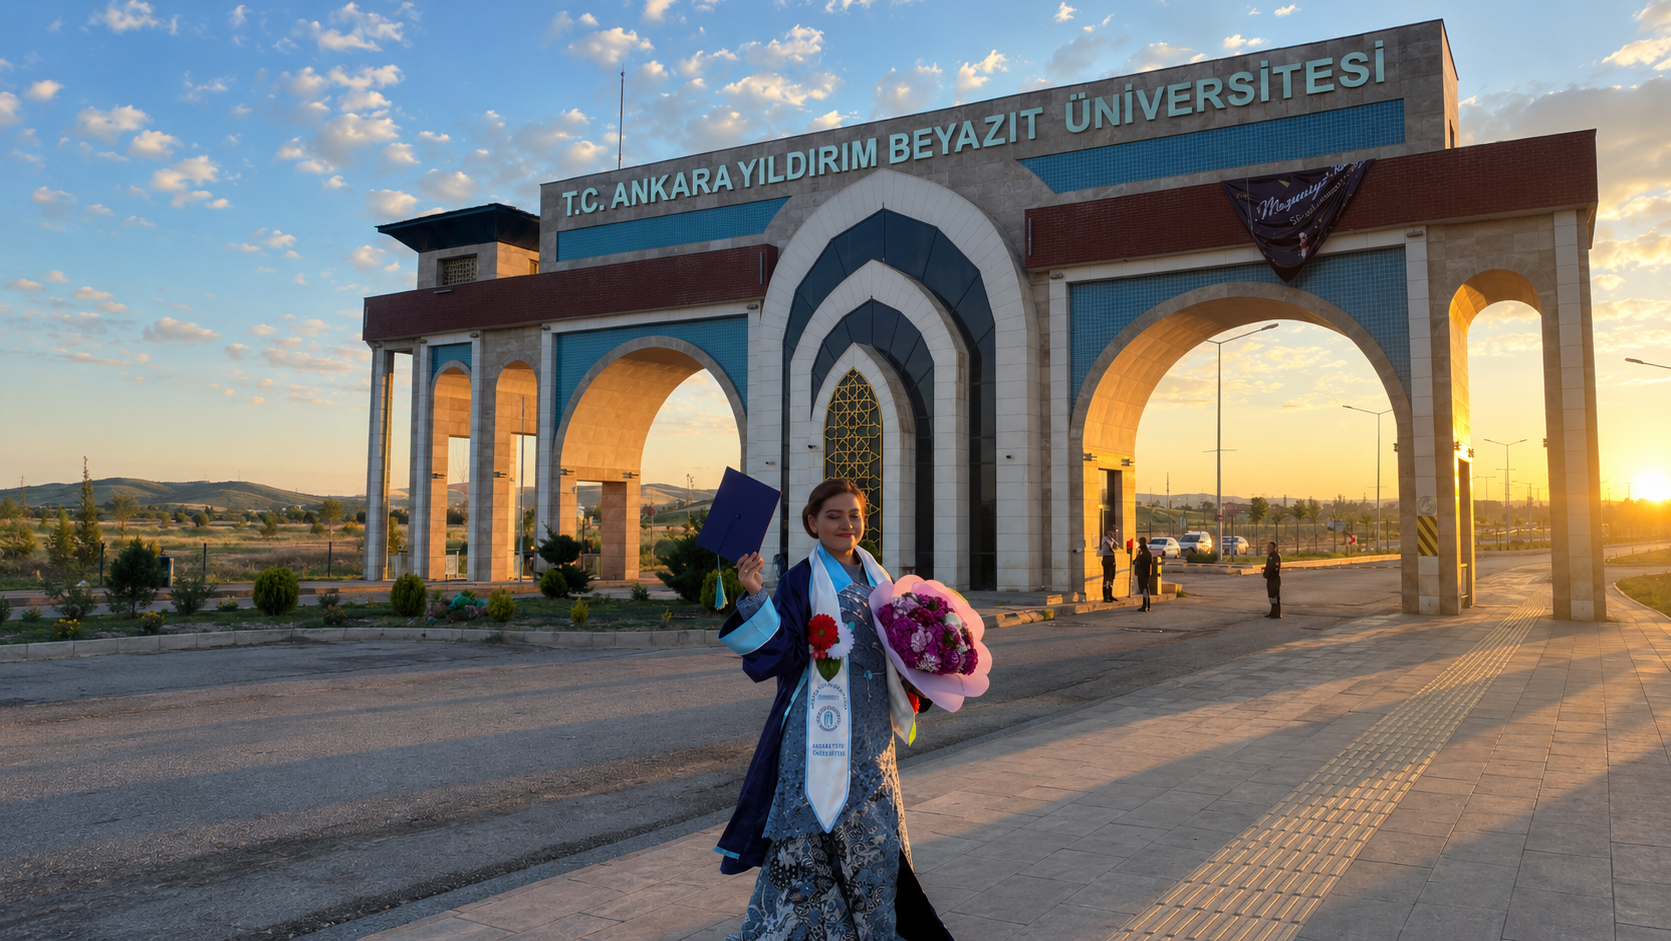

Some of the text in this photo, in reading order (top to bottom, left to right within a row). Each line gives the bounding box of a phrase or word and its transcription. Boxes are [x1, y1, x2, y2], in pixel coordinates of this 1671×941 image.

[562, 40, 1385, 216] T.C. ANKARA YILDIRIM BEYAZIT ÜNİVERSİTESİ
